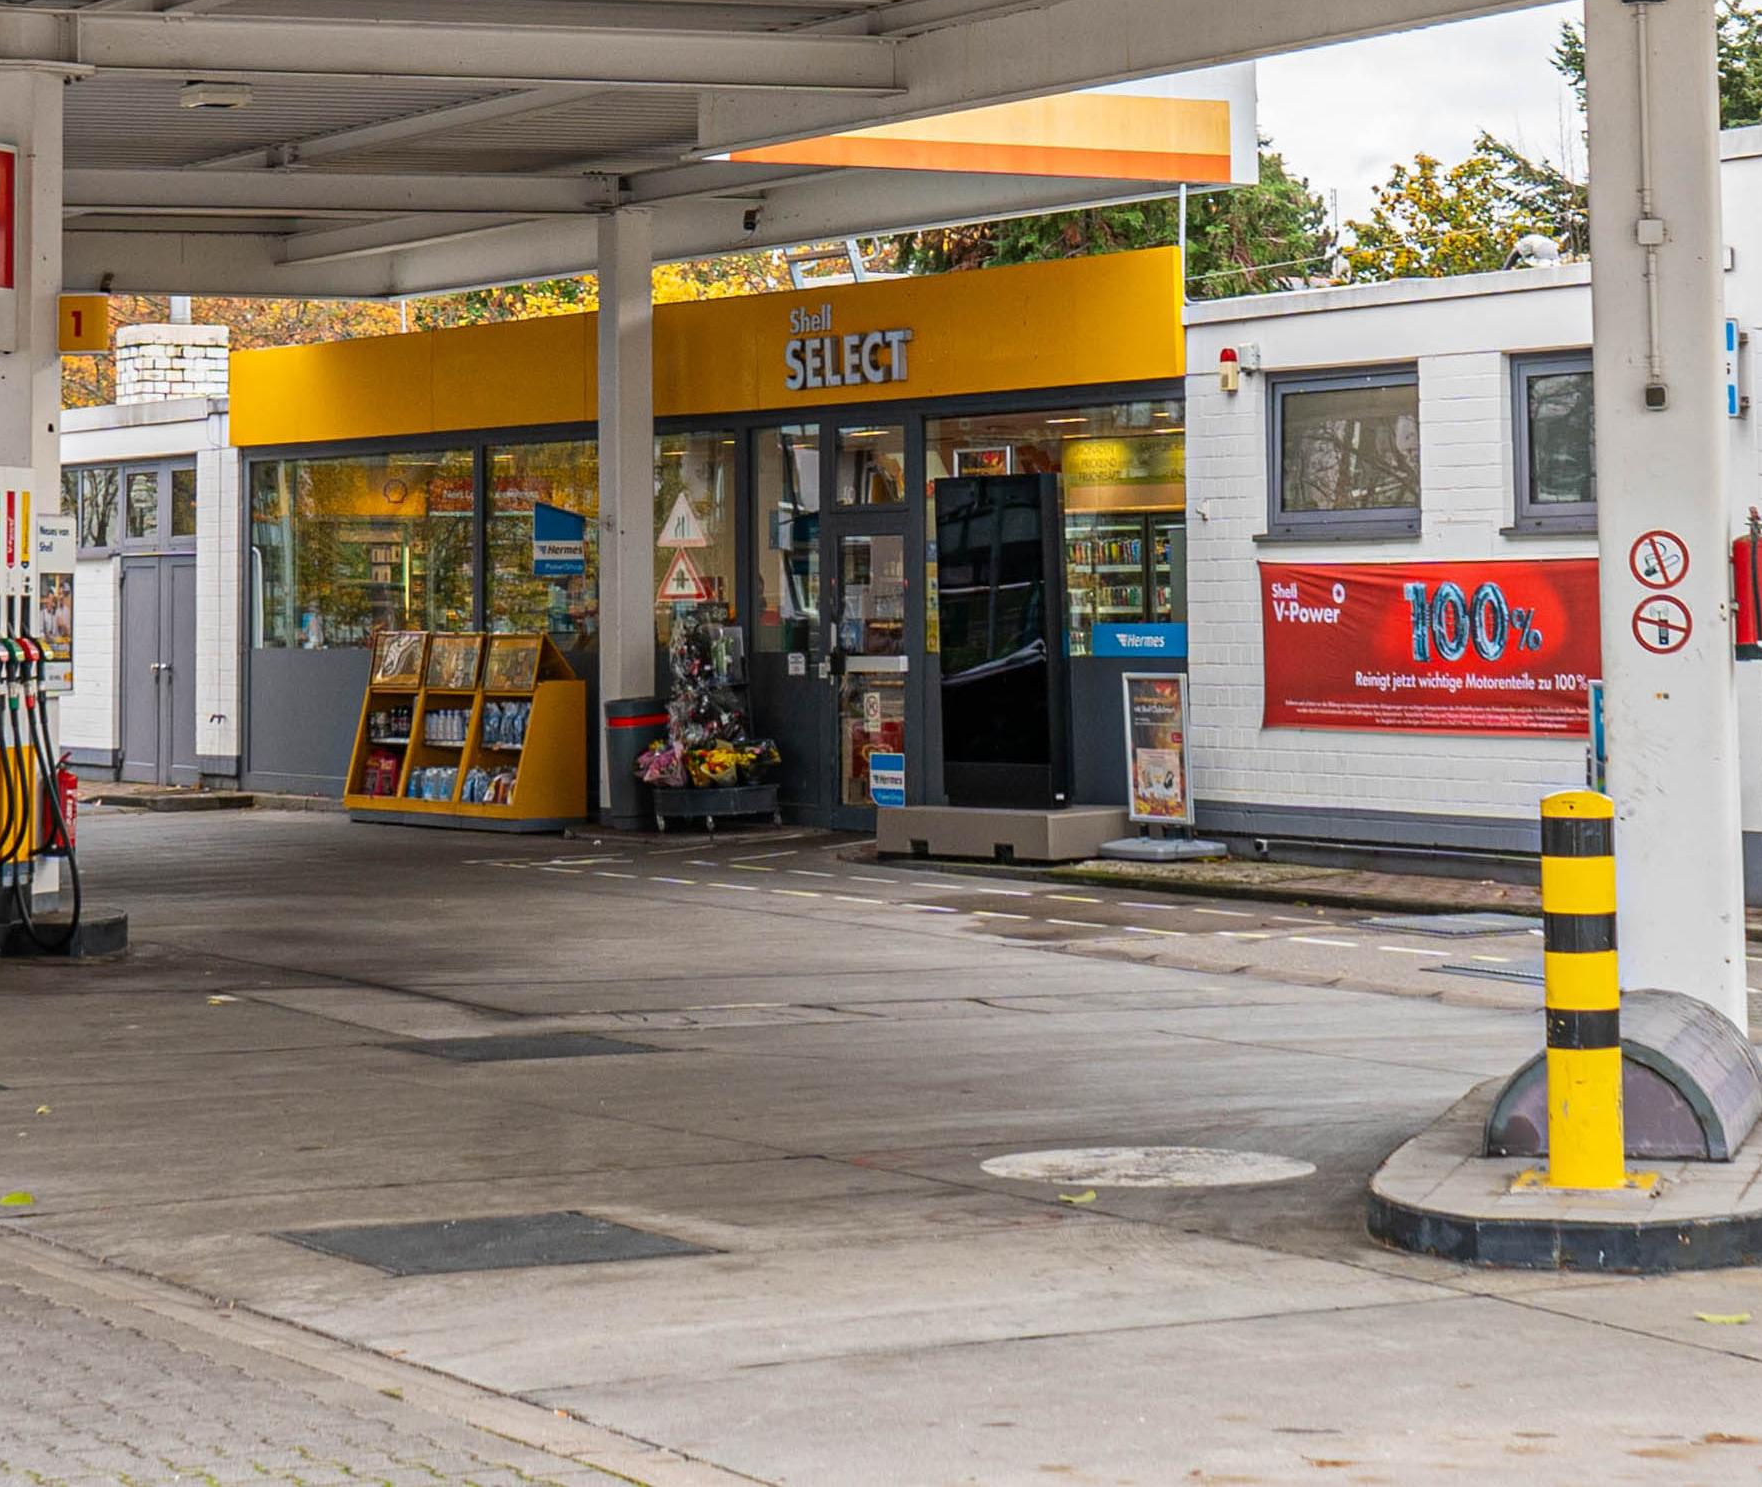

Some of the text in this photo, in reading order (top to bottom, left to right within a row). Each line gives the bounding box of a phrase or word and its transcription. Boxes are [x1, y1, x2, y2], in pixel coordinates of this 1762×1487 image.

[71, 310, 82, 338] 1
[789, 304, 831, 335] Shell
[784, 329, 913, 391] SELECT
[39, 541, 53, 553] Shell
[547, 545, 583, 555] Hermes
[1271, 583, 1298, 600] Shell
[1272, 600, 1341, 625] V-Power
[1403, 581, 1543, 663] 100%
[1127, 633, 1166, 648] Hermes
[1355, 671, 1391, 692] Reinigt
[1391, 672, 1416, 692] jetzt
[1418, 672, 1463, 693] wichtige
[1466, 672, 1535, 690] Motorenteile
[1537, 680, 1552, 690] zu
